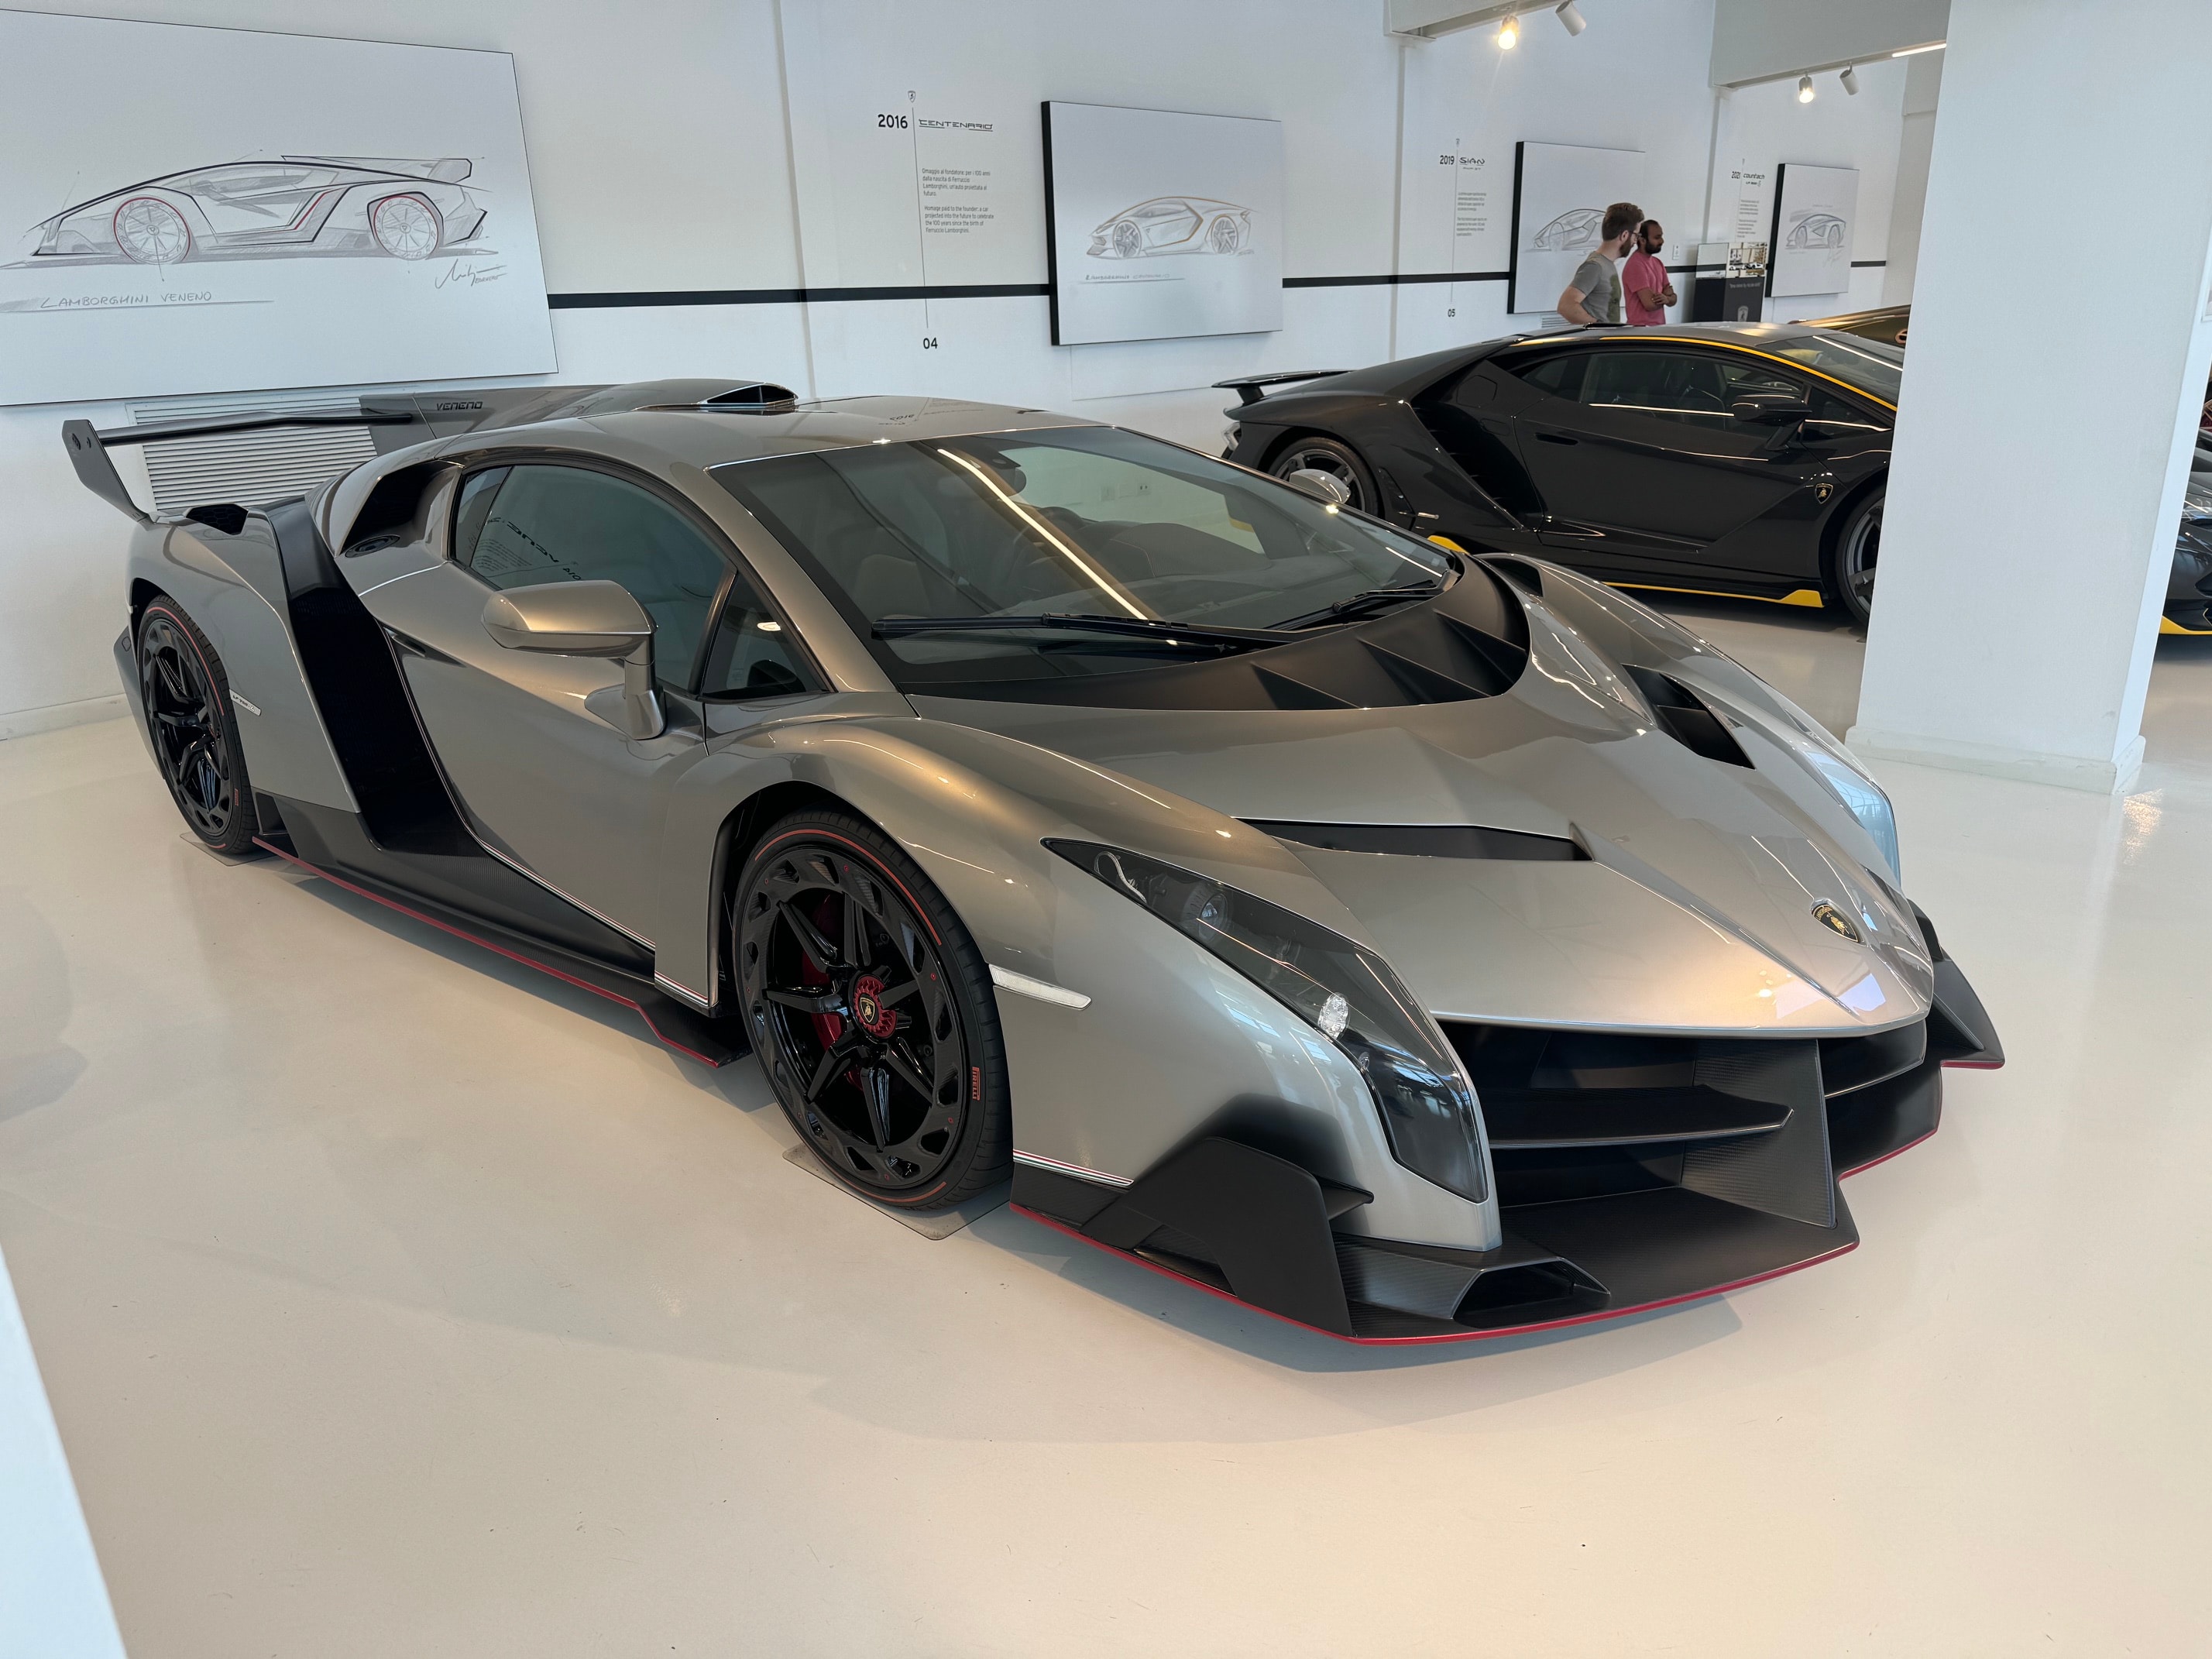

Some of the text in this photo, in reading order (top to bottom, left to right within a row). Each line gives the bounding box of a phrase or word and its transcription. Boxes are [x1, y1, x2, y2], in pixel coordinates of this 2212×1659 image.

[878, 114, 908, 129] 2016
[1440, 155, 1455, 165] 2019
[40, 291, 212, 309] LAMBORGHINI VENENO
[1448, 308, 1456, 317] 05
[923, 337, 938, 349] 04
[436, 401, 483, 411] VENENO
